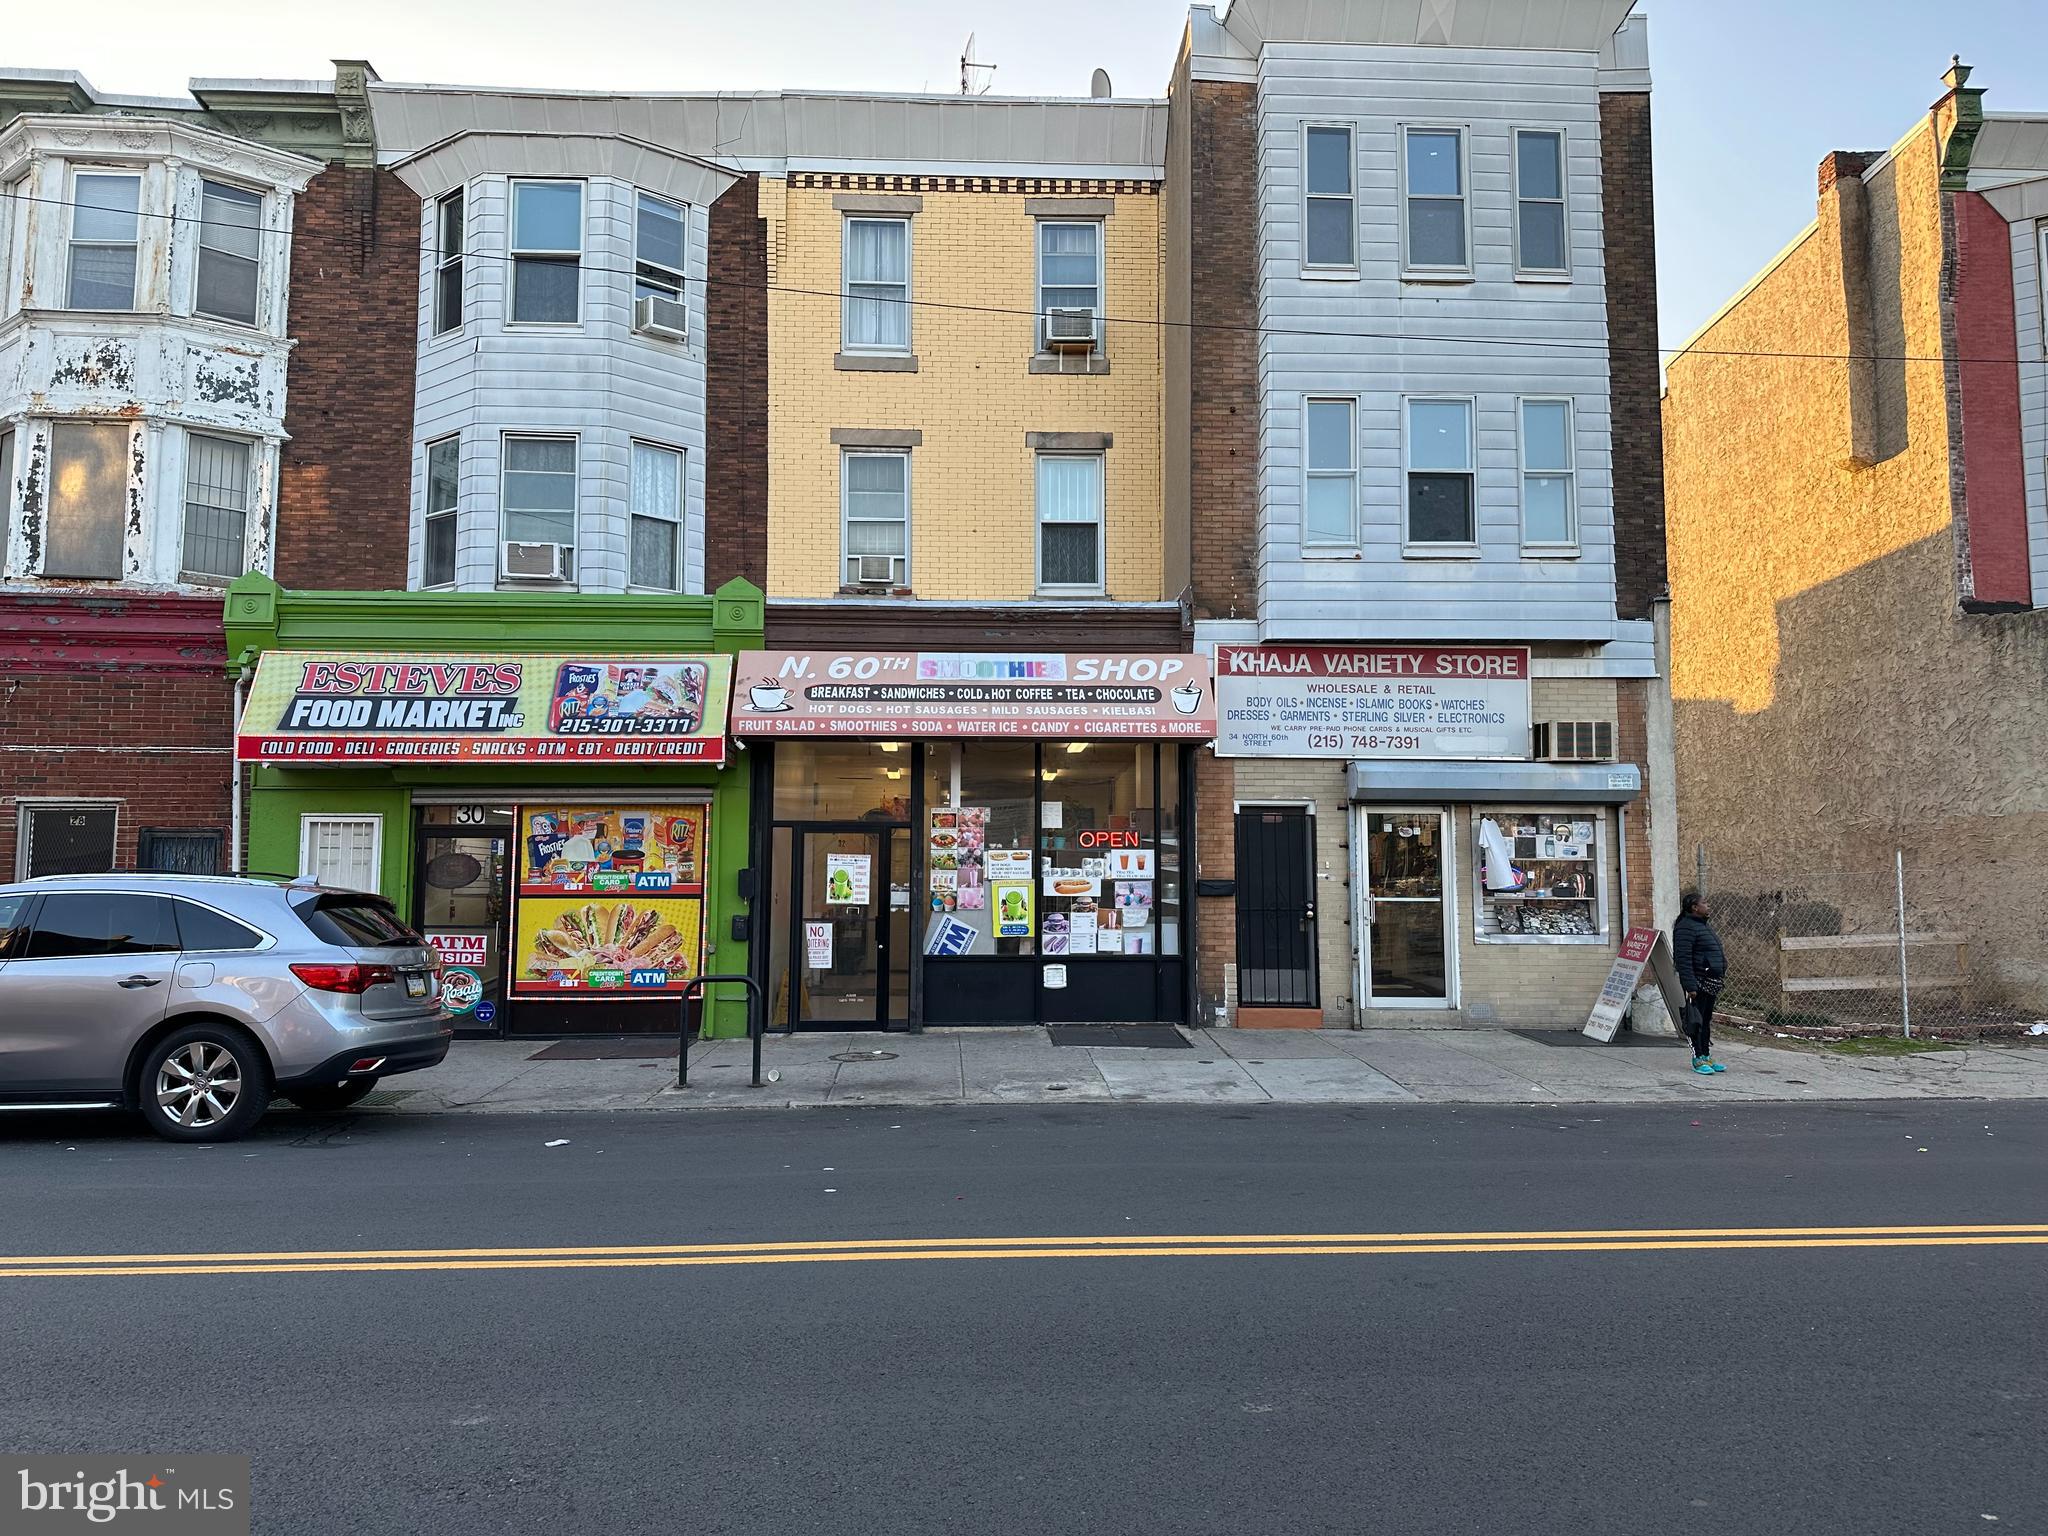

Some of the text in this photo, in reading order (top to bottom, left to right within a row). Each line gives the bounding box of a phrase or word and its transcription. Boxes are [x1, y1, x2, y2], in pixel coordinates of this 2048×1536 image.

[778, 656, 1184, 682] N. 60TH SMOOTHIES SHOP
[1230, 652, 1518, 675] KHAJA VARIETY STORE
[296, 662, 522, 695] ESTEVES
[568, 672, 597, 684] FROSTIES
[811, 686, 1155, 701] BREAKFAST SANDWICHES COLD & HOT COFFEE TEA CHOCOLATE
[1307, 684, 1436, 695] WHOLESALE & RETAIL
[560, 701, 581, 717] RITZ
[809, 704, 1156, 716] HOT DOGS HOT SAUSAGES MILD SAUSAGES KIELBASI
[1246, 697, 1485, 710] BODY OILS INCENSE ISLAMIC BOOKS WATCHES
[290, 700, 525, 728] FOOD MARKET INC
[1227, 710, 1505, 724] DRESSES GARMENTS STERLING SILVER ELECTRONICS
[559, 719, 690, 733] 215-307-3377
[738, 719, 773, 731] FRUIT
[775, 720, 815, 731] SALAD
[829, 720, 897, 732] SMOOTHIES
[911, 720, 943, 732] SODA
[957, 721, 995, 732] WATER
[999, 721, 1017, 732] ICE
[1031, 721, 1069, 733] CANDY
[1084, 722, 1157, 733] CIGARETTES
[1161, 725, 1166, 733] &
[1307, 734, 1420, 749] (215) 748-7391
[260, 742, 706, 756] COLD FOOD DELI GROCERIES SNACKS ATM EBT DEBIT/CREDIT
[71, 816, 84, 825] 28
[457, 805, 485, 824] 30
[671, 822, 690, 840] RITZ
[1079, 831, 1139, 848] OPEN
[637, 876, 670, 887] ATM
[810, 926, 824, 937] NO
[430, 936, 485, 950] ATM
[938, 923, 970, 955] TM
[1626, 940, 1650, 951] VARIETY
[440, 953, 483, 963] SIDE
[1626, 950, 1643, 958] STORE
[632, 972, 665, 984] ATM
